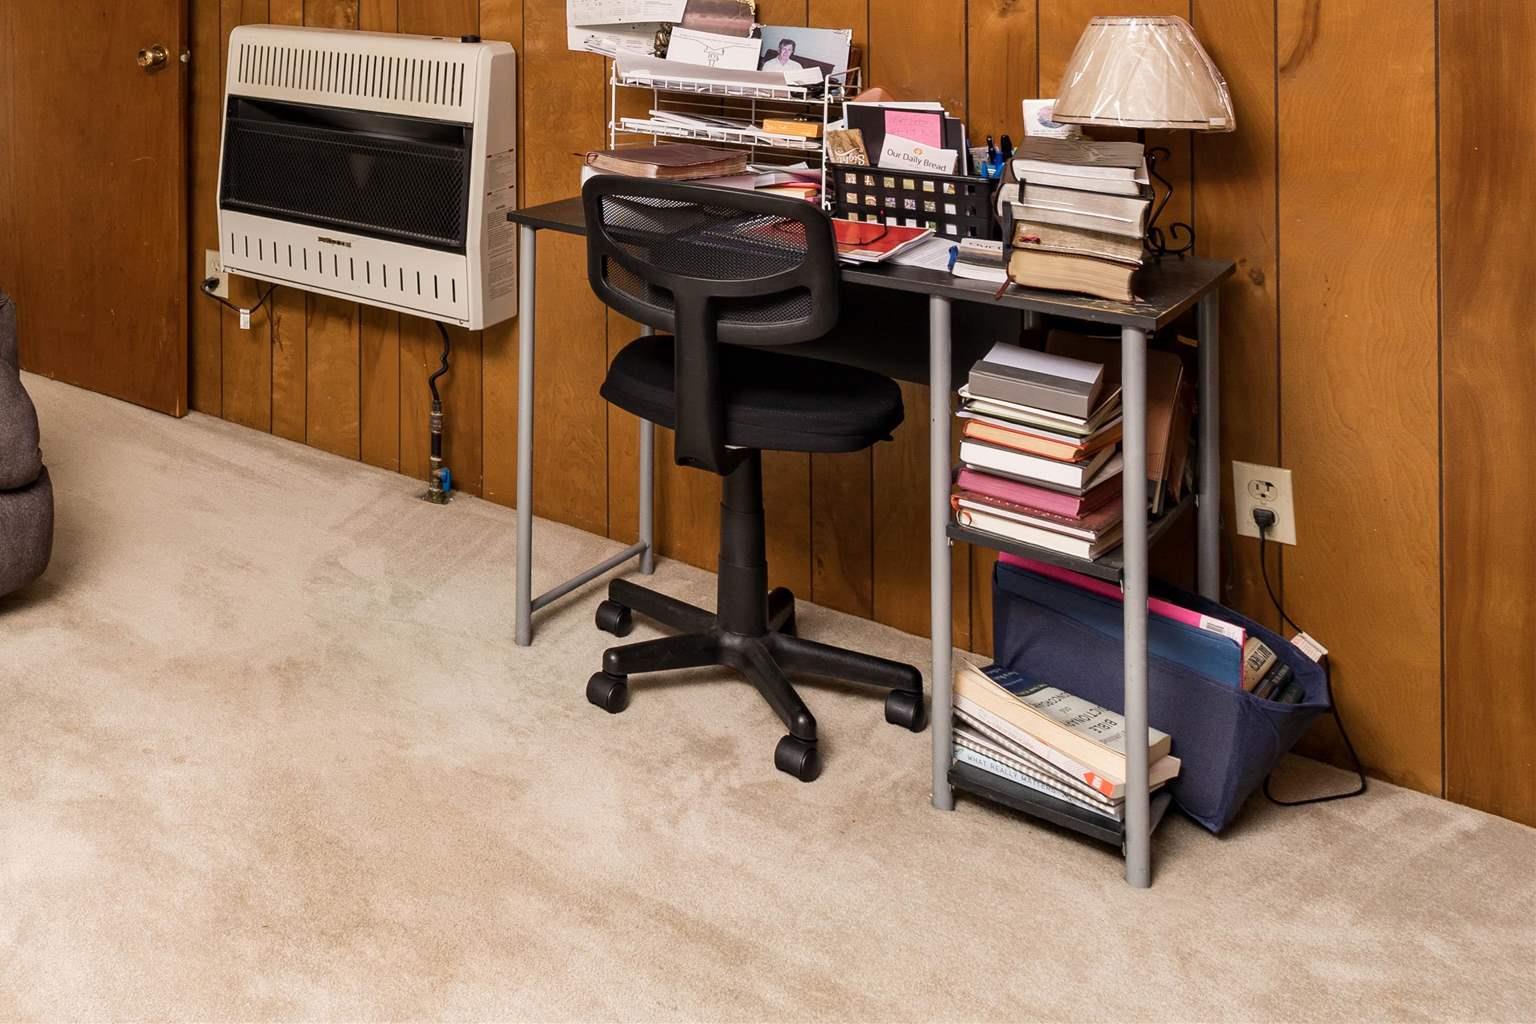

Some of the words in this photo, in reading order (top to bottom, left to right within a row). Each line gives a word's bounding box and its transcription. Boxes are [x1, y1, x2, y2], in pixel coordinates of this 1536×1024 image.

[886, 148, 902, 159] Our
[902, 152, 923, 166] Daily
[923, 158, 947, 172] Bread
[967, 754, 987, 767] WHAT
[990, 762, 1018, 778] REALLY
